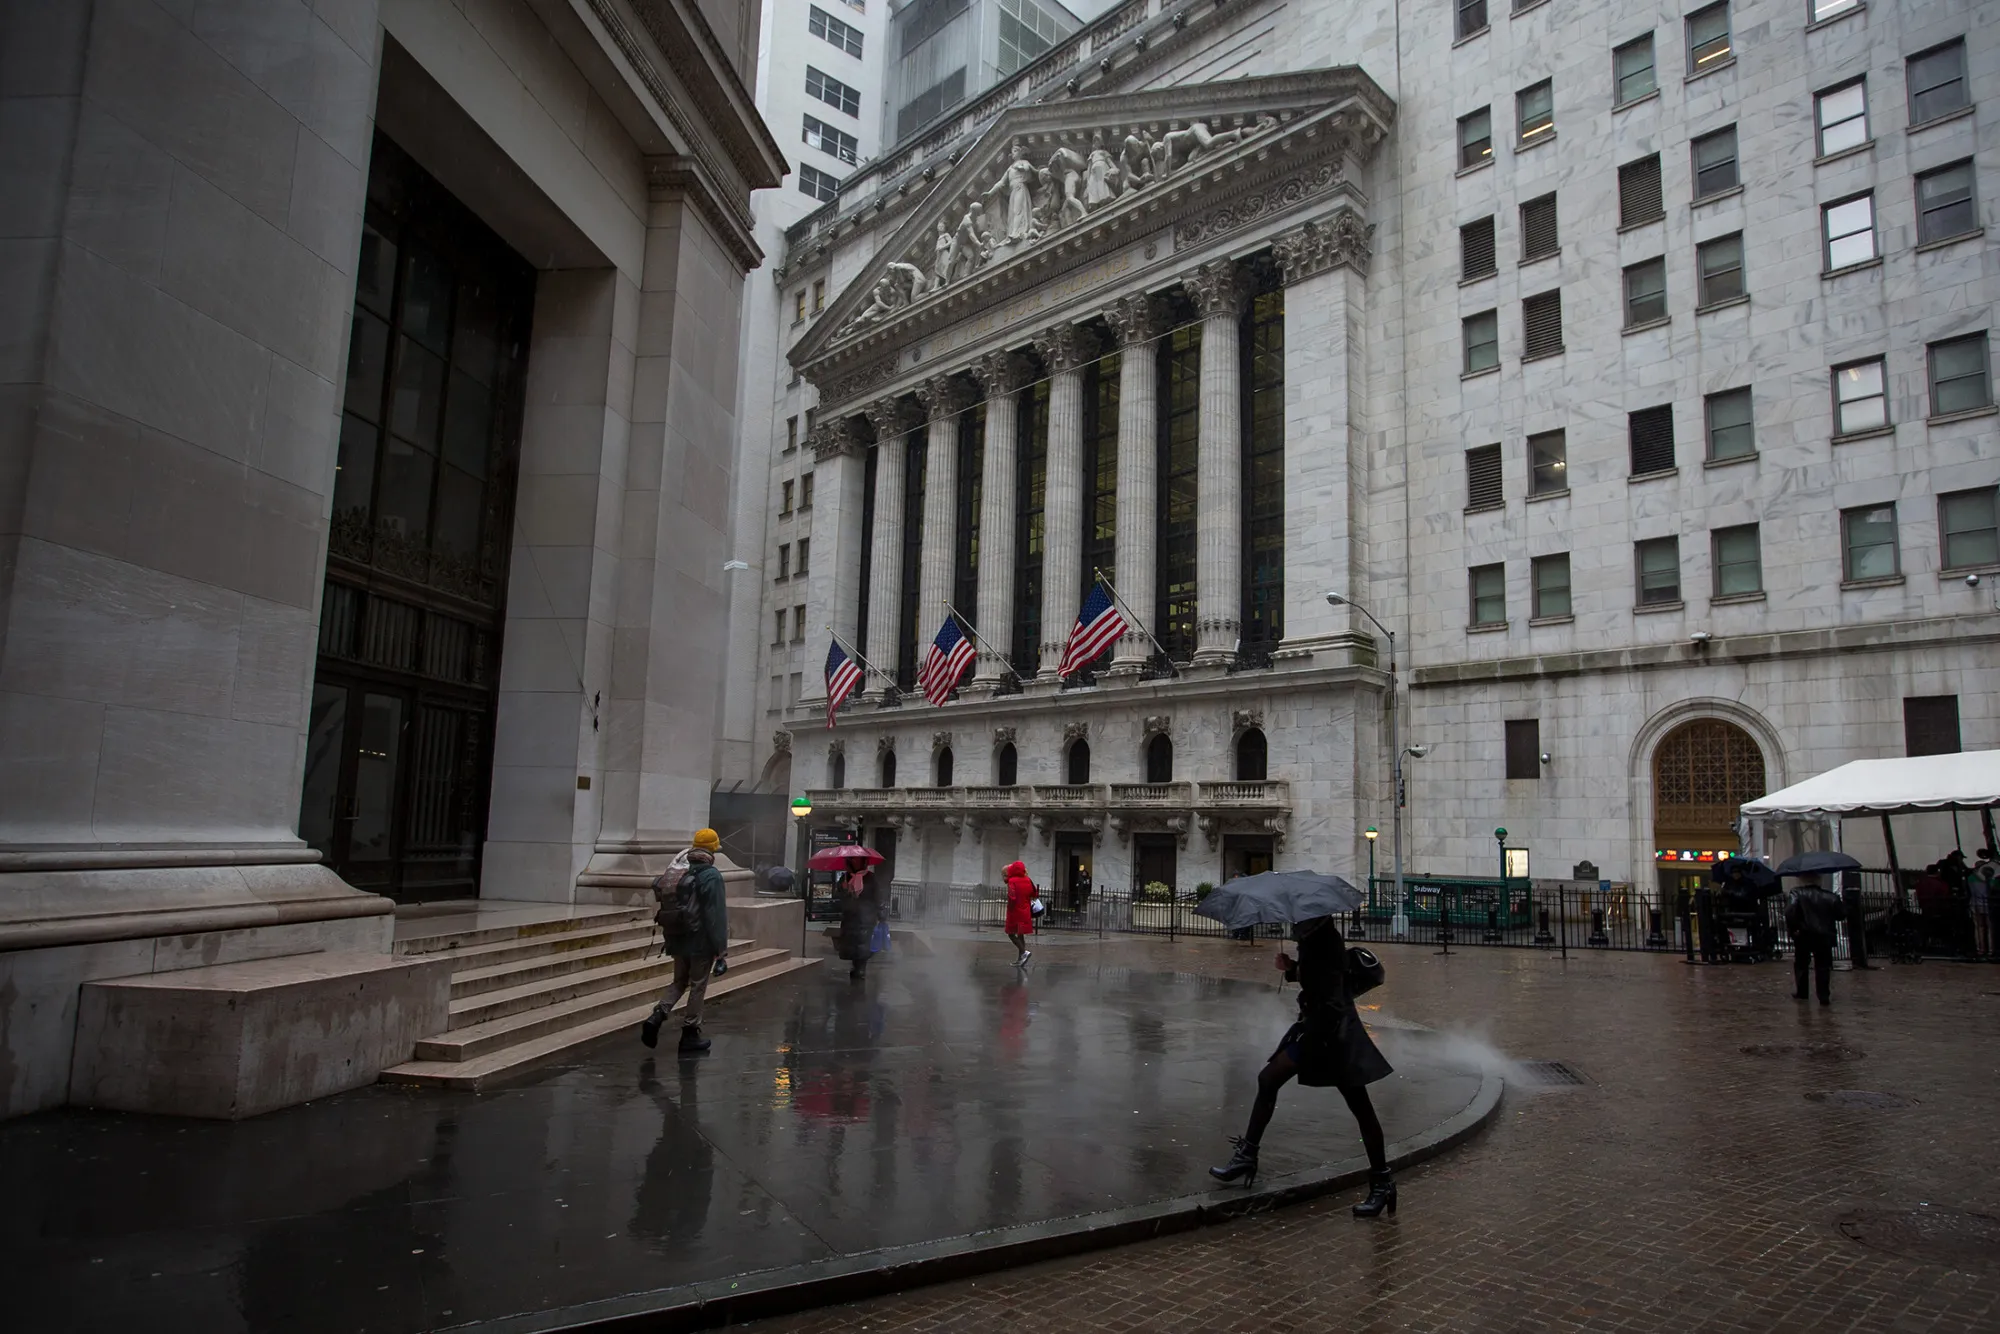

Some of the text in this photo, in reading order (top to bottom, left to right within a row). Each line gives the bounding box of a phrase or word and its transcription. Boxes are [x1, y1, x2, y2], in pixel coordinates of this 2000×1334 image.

[962, 315, 995, 341] YORK
[1003, 294, 1045, 322] STOCK
[1051, 253, 1130, 301] EXCHANGE
[1413, 885, 1441, 894] Subway
